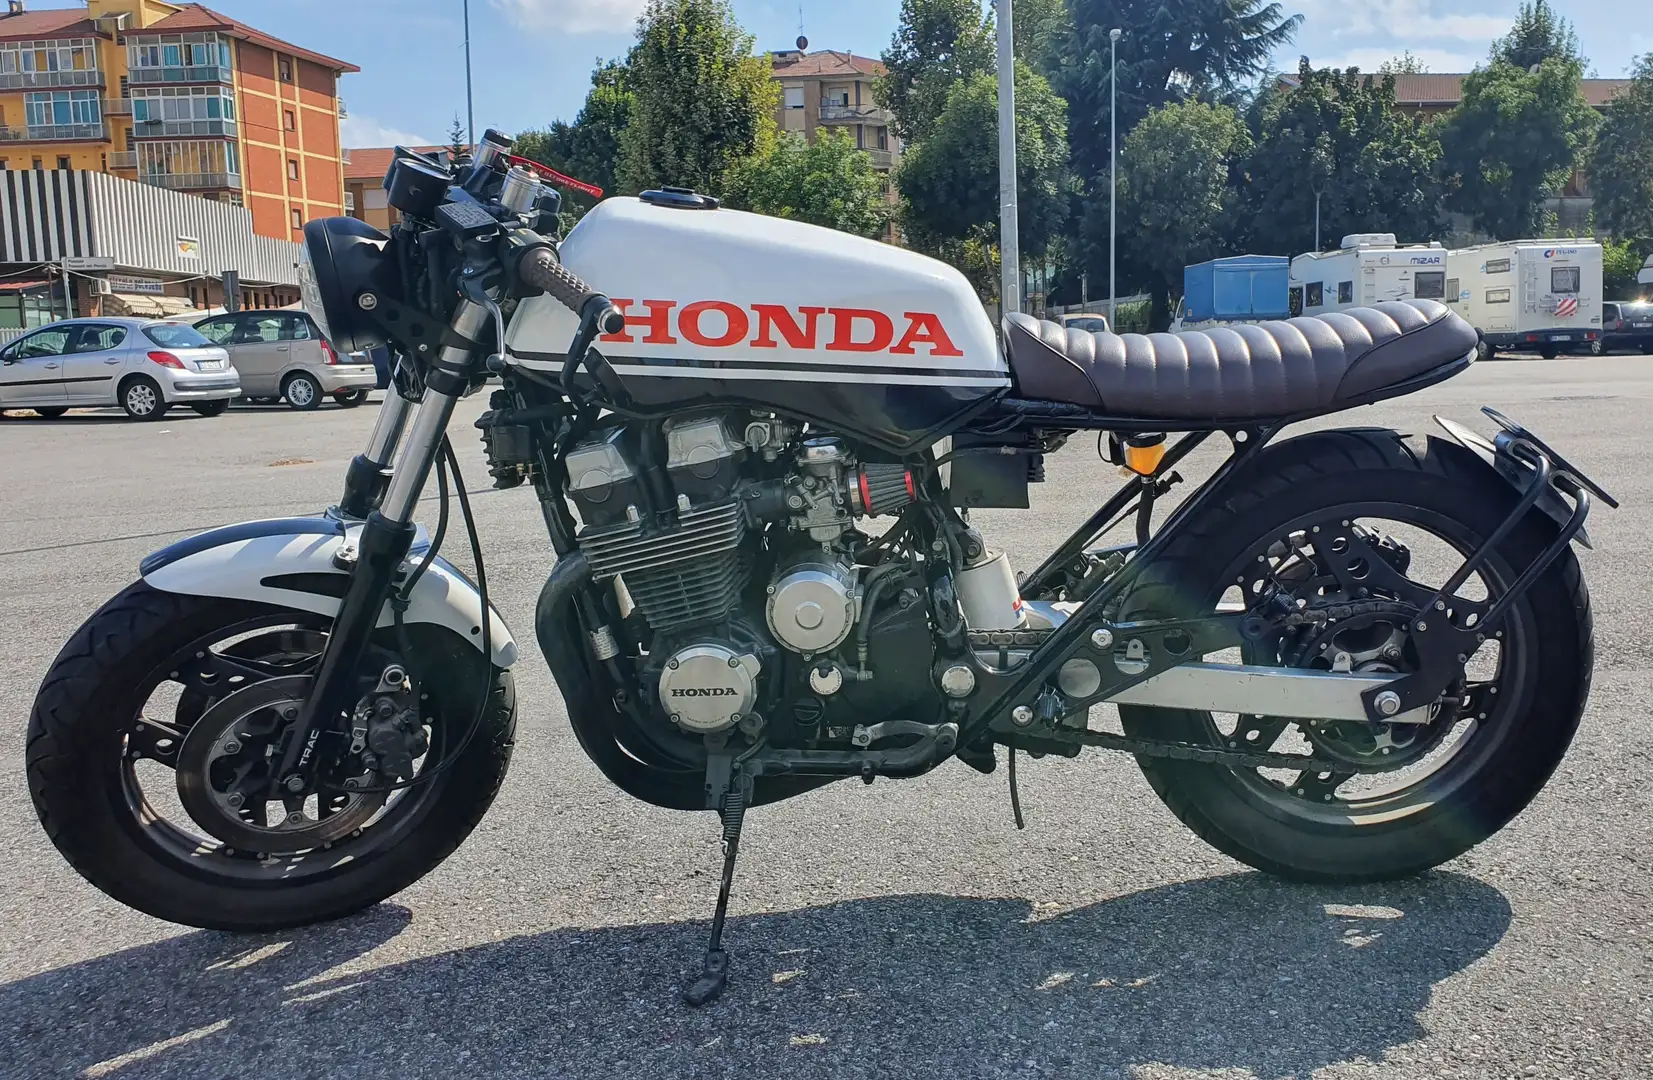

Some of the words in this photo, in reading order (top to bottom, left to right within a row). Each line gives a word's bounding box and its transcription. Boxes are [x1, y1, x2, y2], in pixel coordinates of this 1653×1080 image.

[1410, 257, 1440, 265] MIZAR
[599, 298, 964, 357] HONDA
[671, 687, 738, 697] HONDA
[299, 729, 320, 767] TRAC
